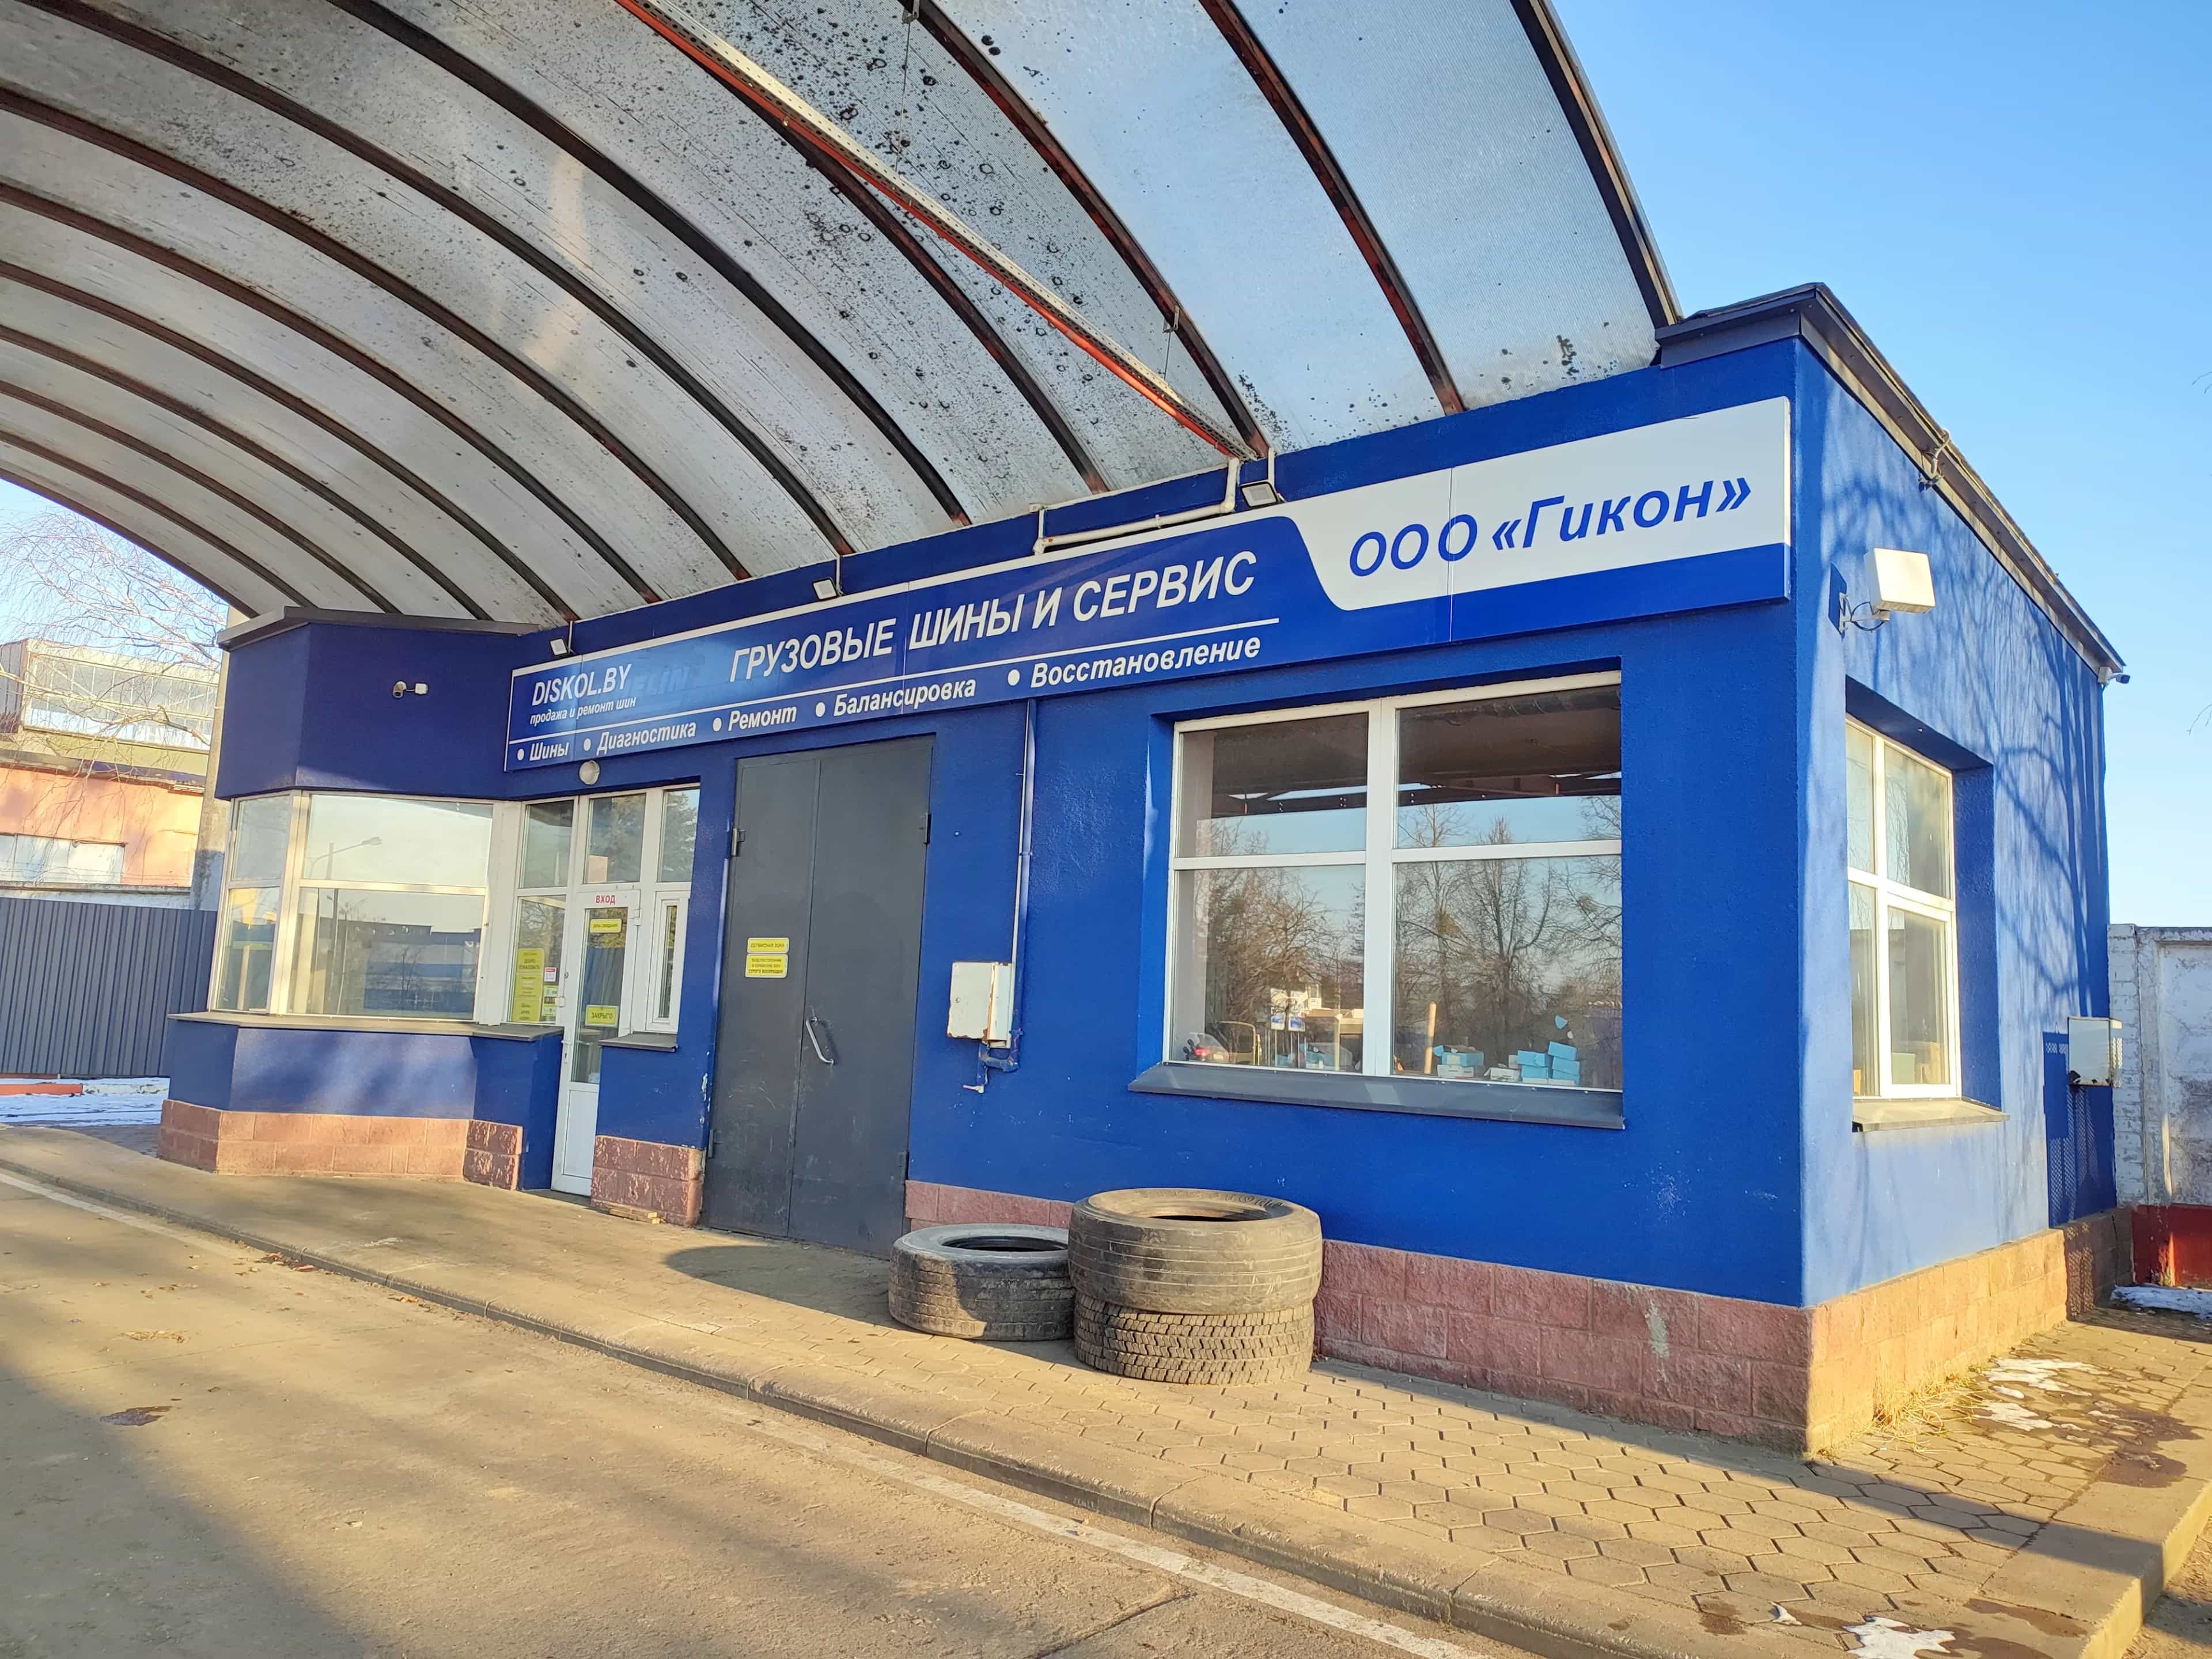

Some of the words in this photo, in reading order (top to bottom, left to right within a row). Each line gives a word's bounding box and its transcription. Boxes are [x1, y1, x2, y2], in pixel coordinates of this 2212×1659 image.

[1349, 514, 1479, 577] ООО
[1491, 476, 1752, 551] «Гикон»
[730, 618, 897, 682] ГРУЗОВЫЕ
[908, 594, 1025, 650] ШИНЫ
[1032, 586, 1062, 630] И
[1073, 550, 1257, 622] СЕРВИС
[1030, 637, 1261, 688] Восстановление
[532, 663, 632, 706] DISKOL.BY
[834, 679, 976, 717] Балансировка
[529, 709, 567, 727] продажа
[569, 706, 576, 717] и
[577, 700, 614, 720] ремонт
[616, 696, 637, 709] шин
[728, 704, 797, 732] Ремонт
[529, 742, 570, 762] Шины
[596, 722, 696, 756] Диагностика
[596, 894, 616, 905] ВХОД
